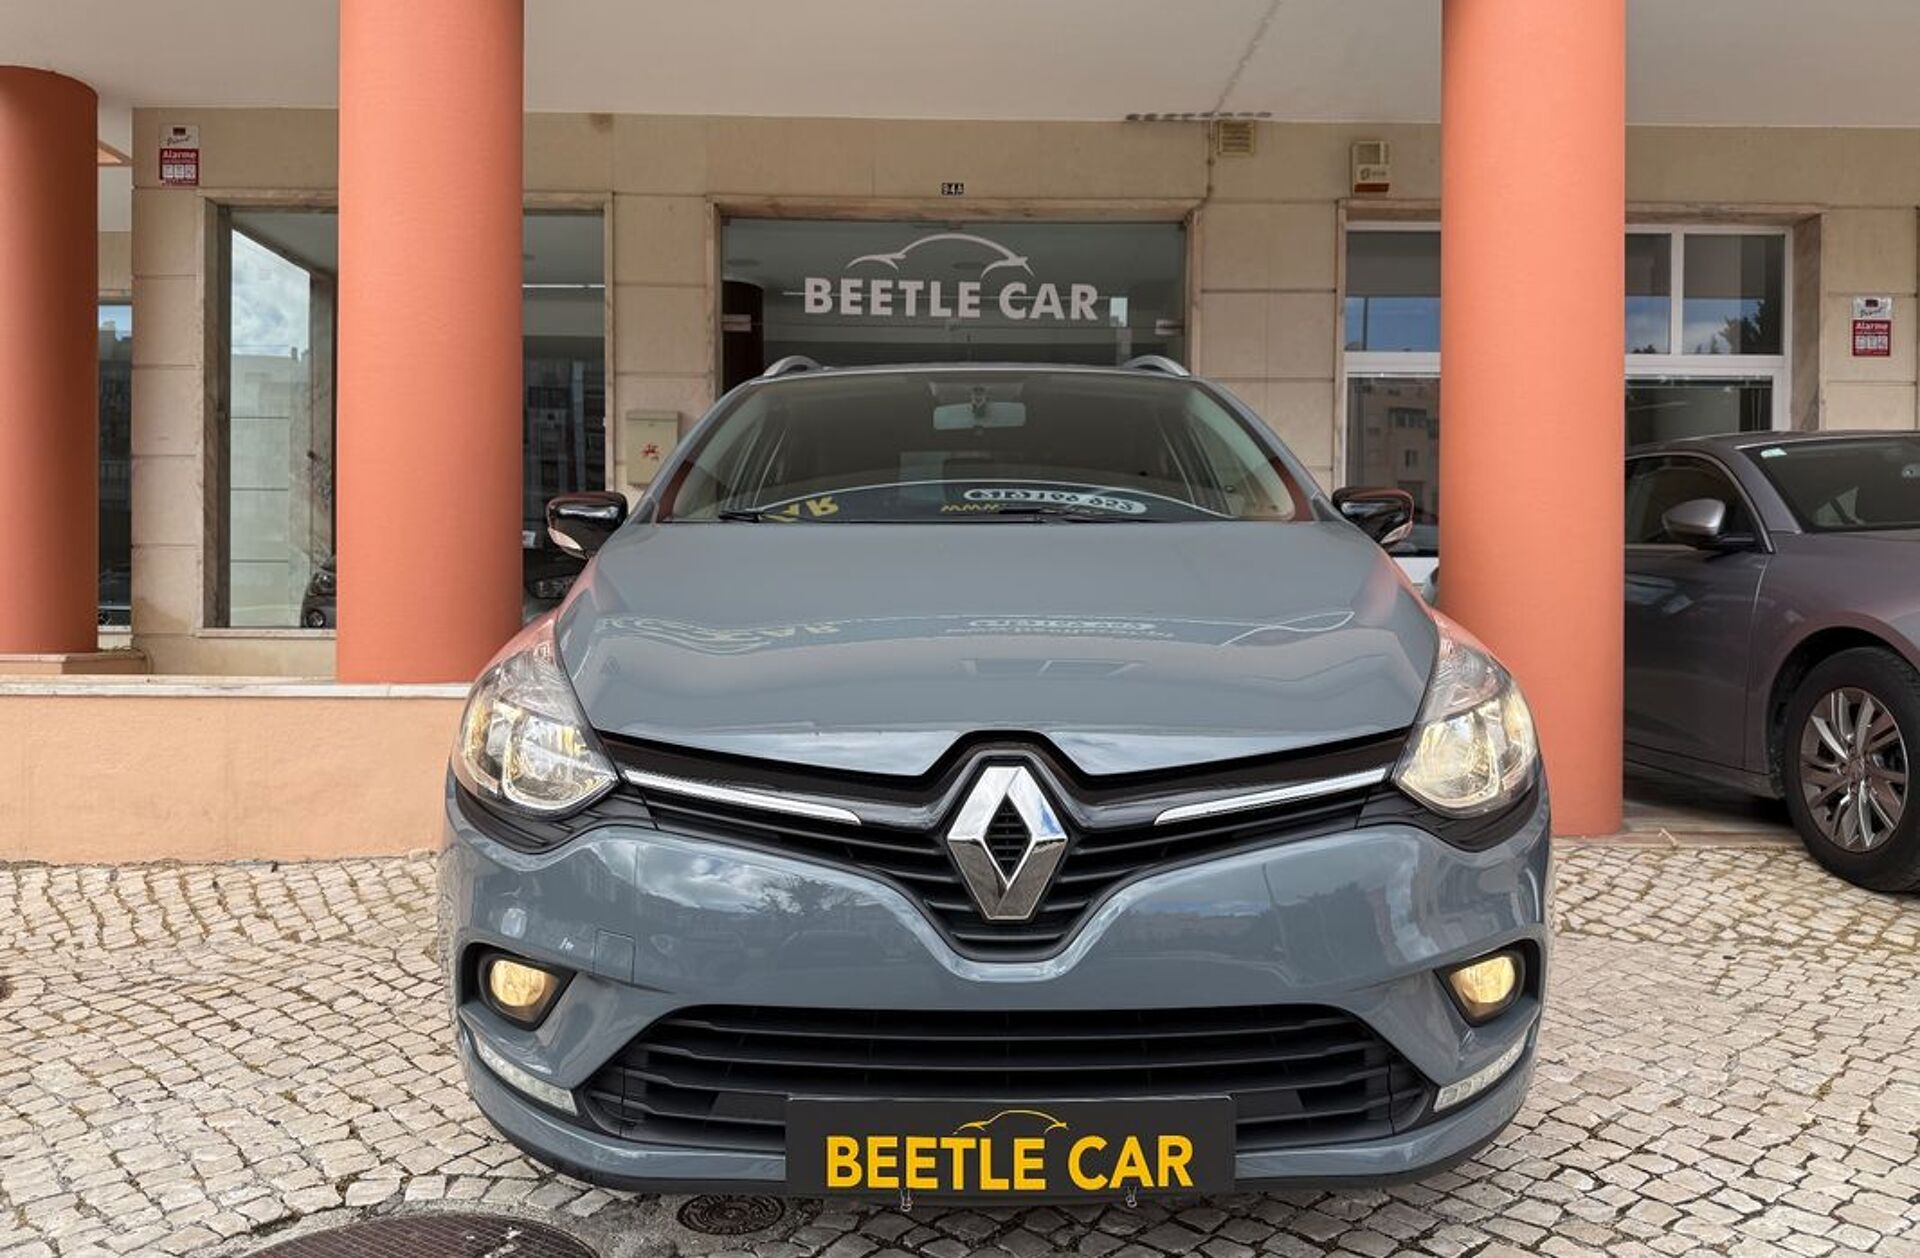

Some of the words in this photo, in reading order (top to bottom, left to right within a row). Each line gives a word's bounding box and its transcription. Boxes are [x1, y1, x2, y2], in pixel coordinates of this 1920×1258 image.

[163, 150, 197, 158] Alarme
[804, 277, 981, 319] BEETLE
[999, 282, 1099, 321] CAR
[1855, 322, 1888, 330] Alarme
[826, 1135, 1047, 1191] BEETLE
[1067, 1134, 1194, 1191] CAR
